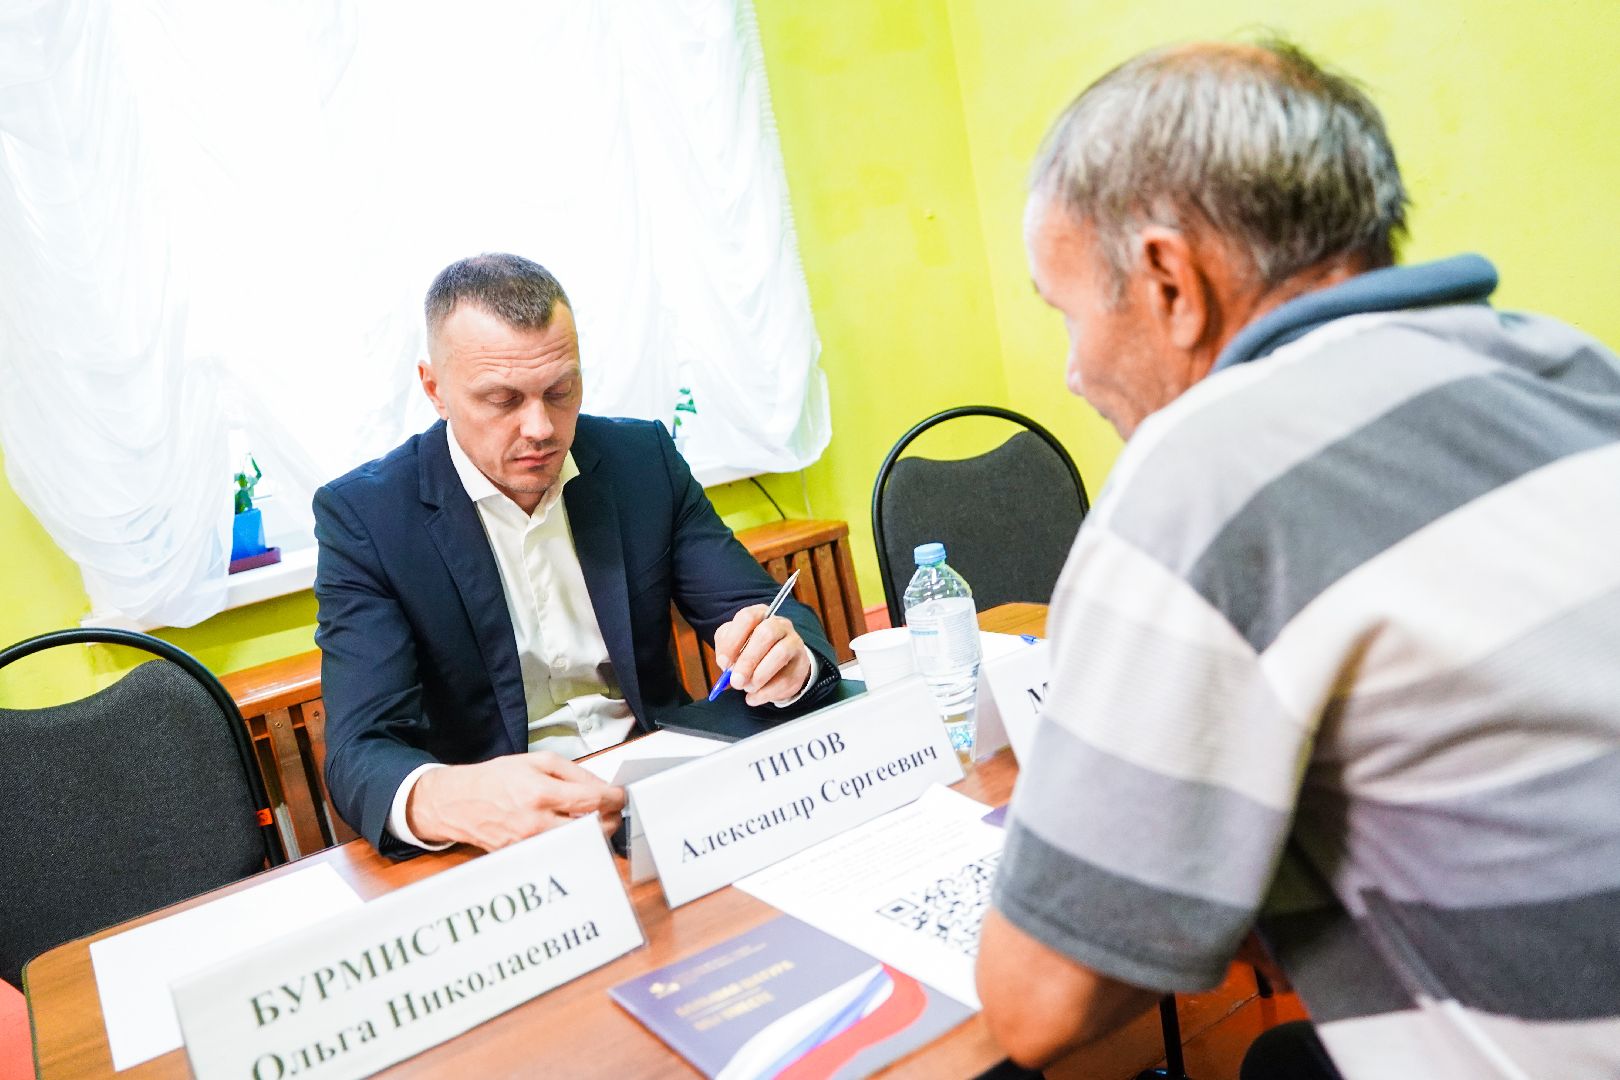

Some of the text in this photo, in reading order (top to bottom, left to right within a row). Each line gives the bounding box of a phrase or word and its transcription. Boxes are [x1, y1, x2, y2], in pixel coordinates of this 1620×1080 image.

[681, 794, 815, 863] Александр
[821, 745, 938, 802] Сергеевич
[748, 731, 846, 783] ТИТОВ
[250, 875, 569, 1027] БУРМИСТРОВА
[252, 1018, 377, 1080] Ольга
[387, 920, 601, 1028] Николаевна
